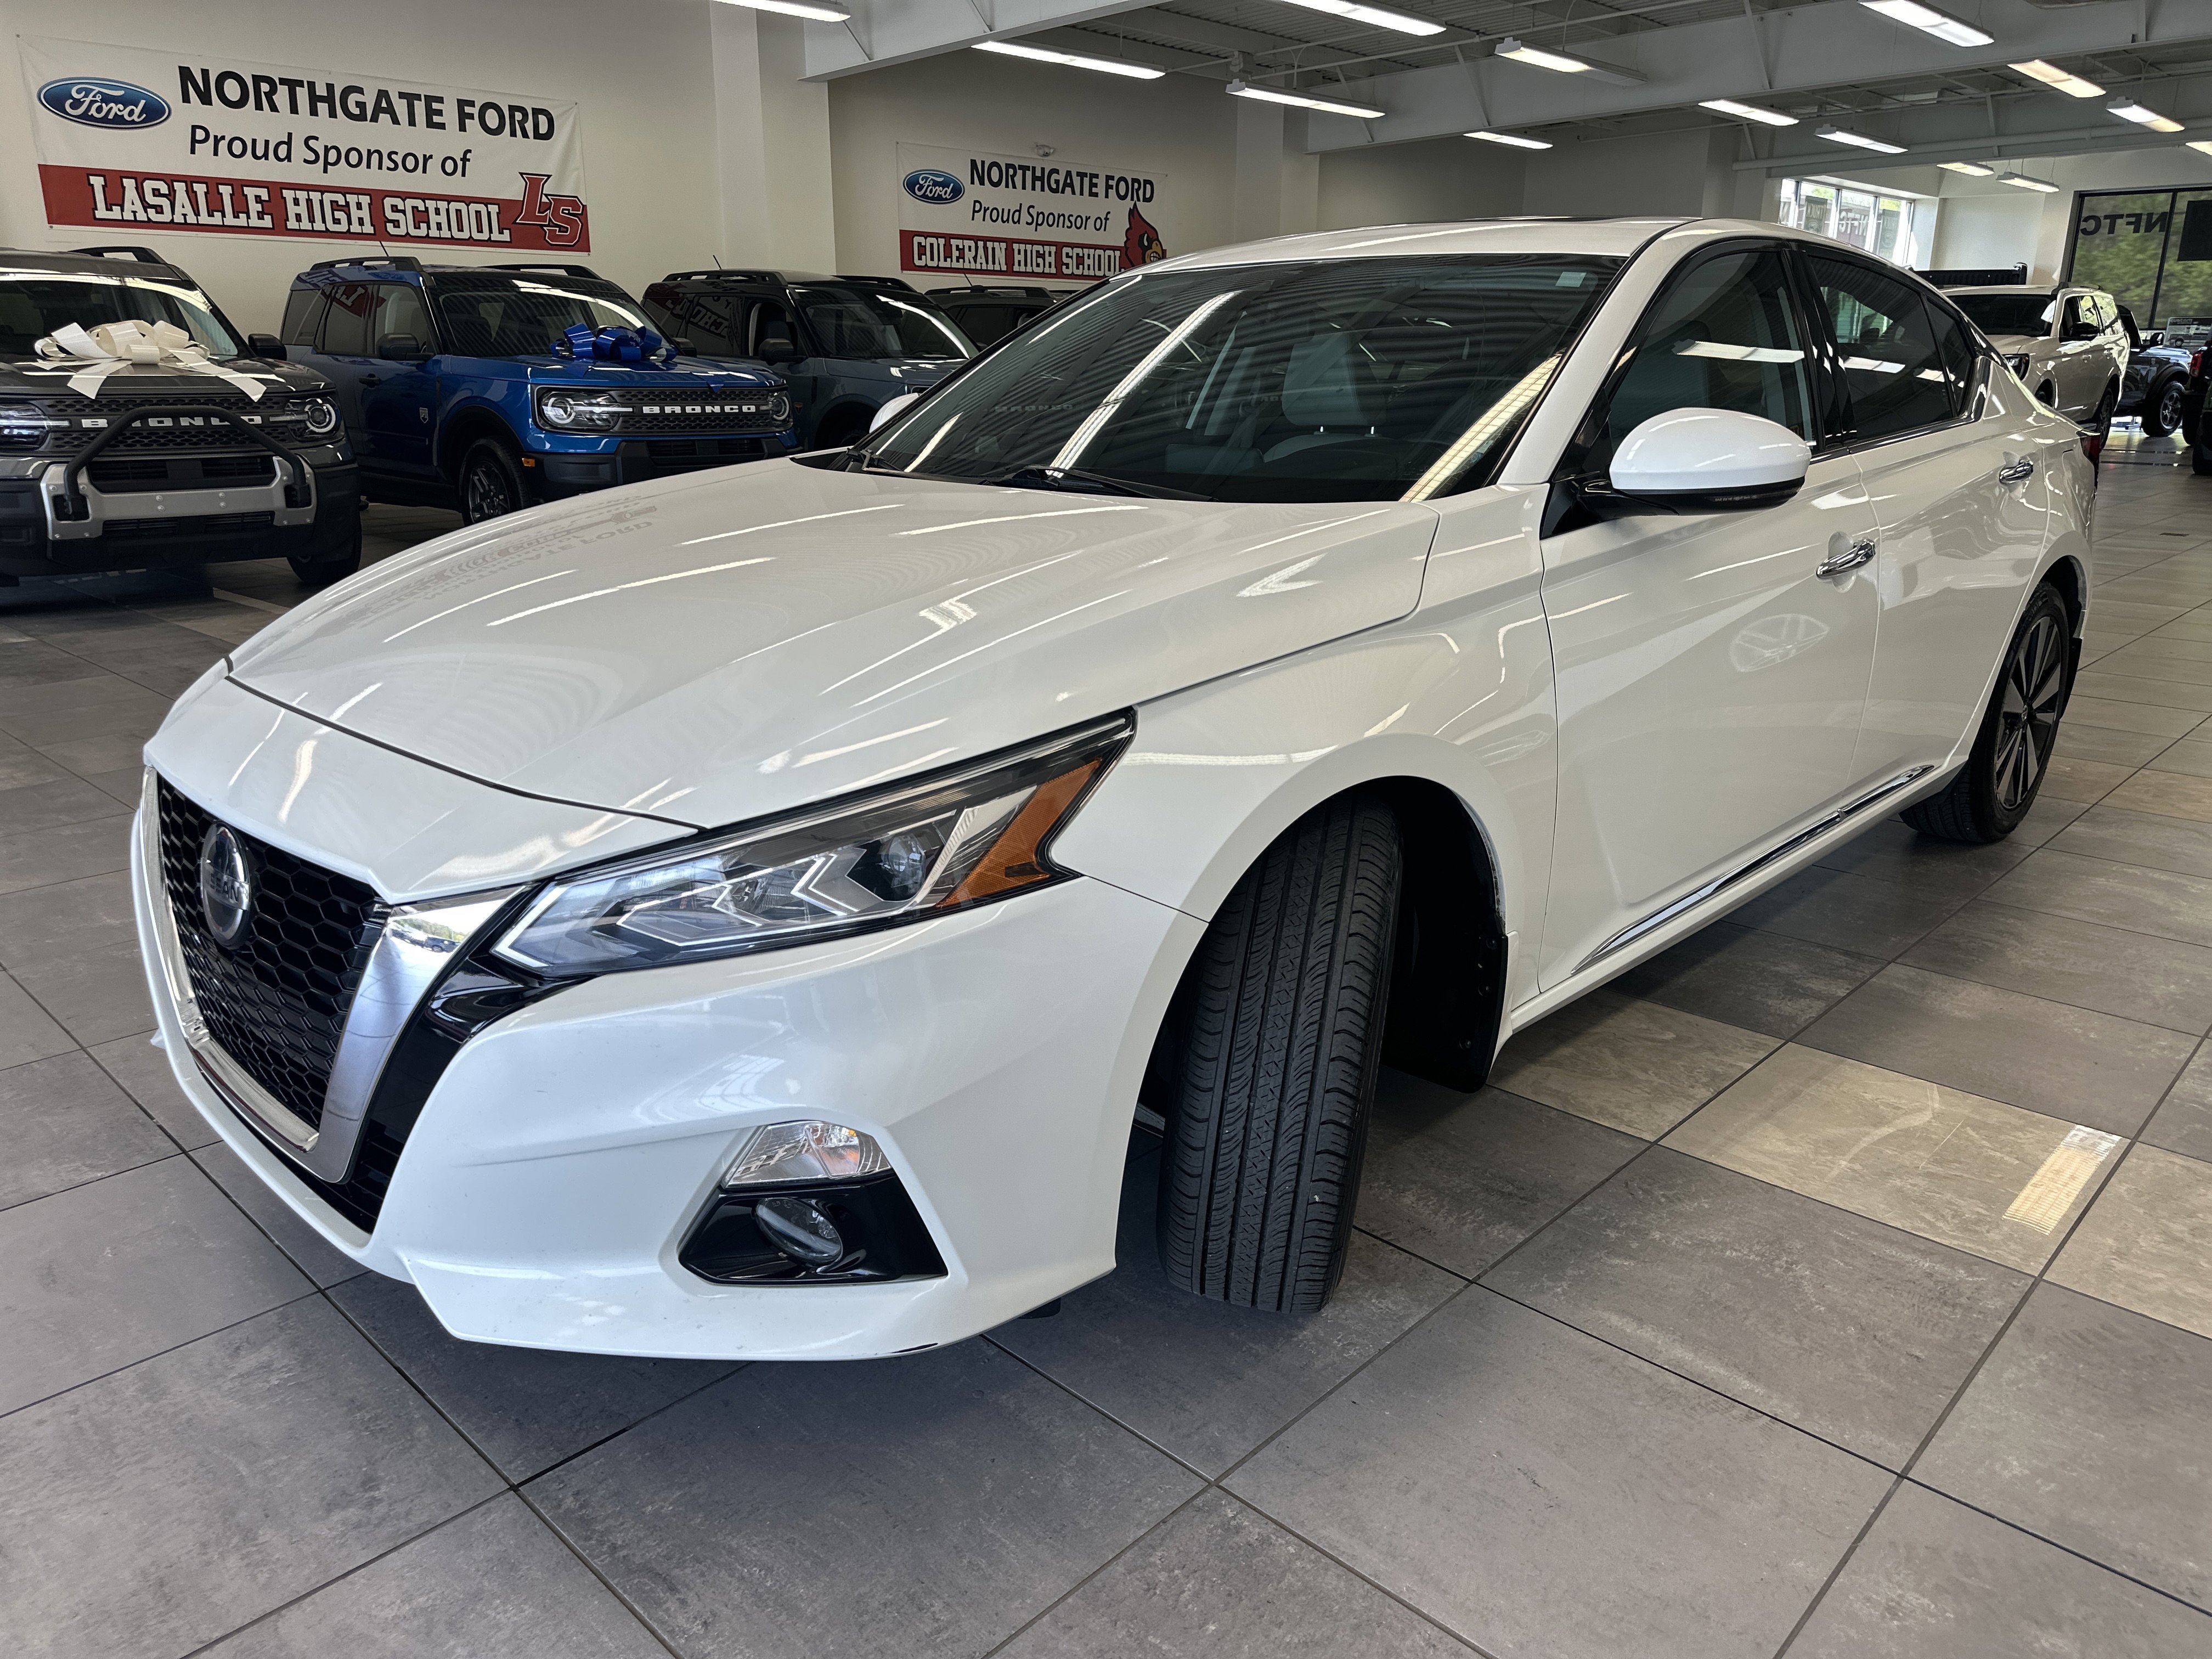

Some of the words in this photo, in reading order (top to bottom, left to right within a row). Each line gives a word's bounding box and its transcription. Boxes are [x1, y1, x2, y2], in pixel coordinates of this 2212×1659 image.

[65, 84, 146, 122] Ford
[178, 66, 446, 131] NORTHGATE
[456, 98, 555, 141] FORD
[190, 125, 293, 163] Proud
[303, 135, 433, 174] Sponsor
[441, 149, 472, 177] of
[915, 174, 953, 199] Ford
[970, 159, 1099, 198] NORTHGATE
[1104, 174, 1154, 203] FORD
[88, 174, 274, 229] LASALLE
[281, 188, 375, 234] HIGH
[383, 195, 511, 242] SCHOOL
[971, 200, 1023, 224] Proud
[1025, 205, 1091, 232] Sponsor
[1093, 211, 1111, 232] of
[912, 235, 1008, 272] COLERAIN
[1012, 242, 1057, 274] HIGH
[1062, 247, 1125, 276] SCHOOL
[642, 405, 756, 414] BRONCO
